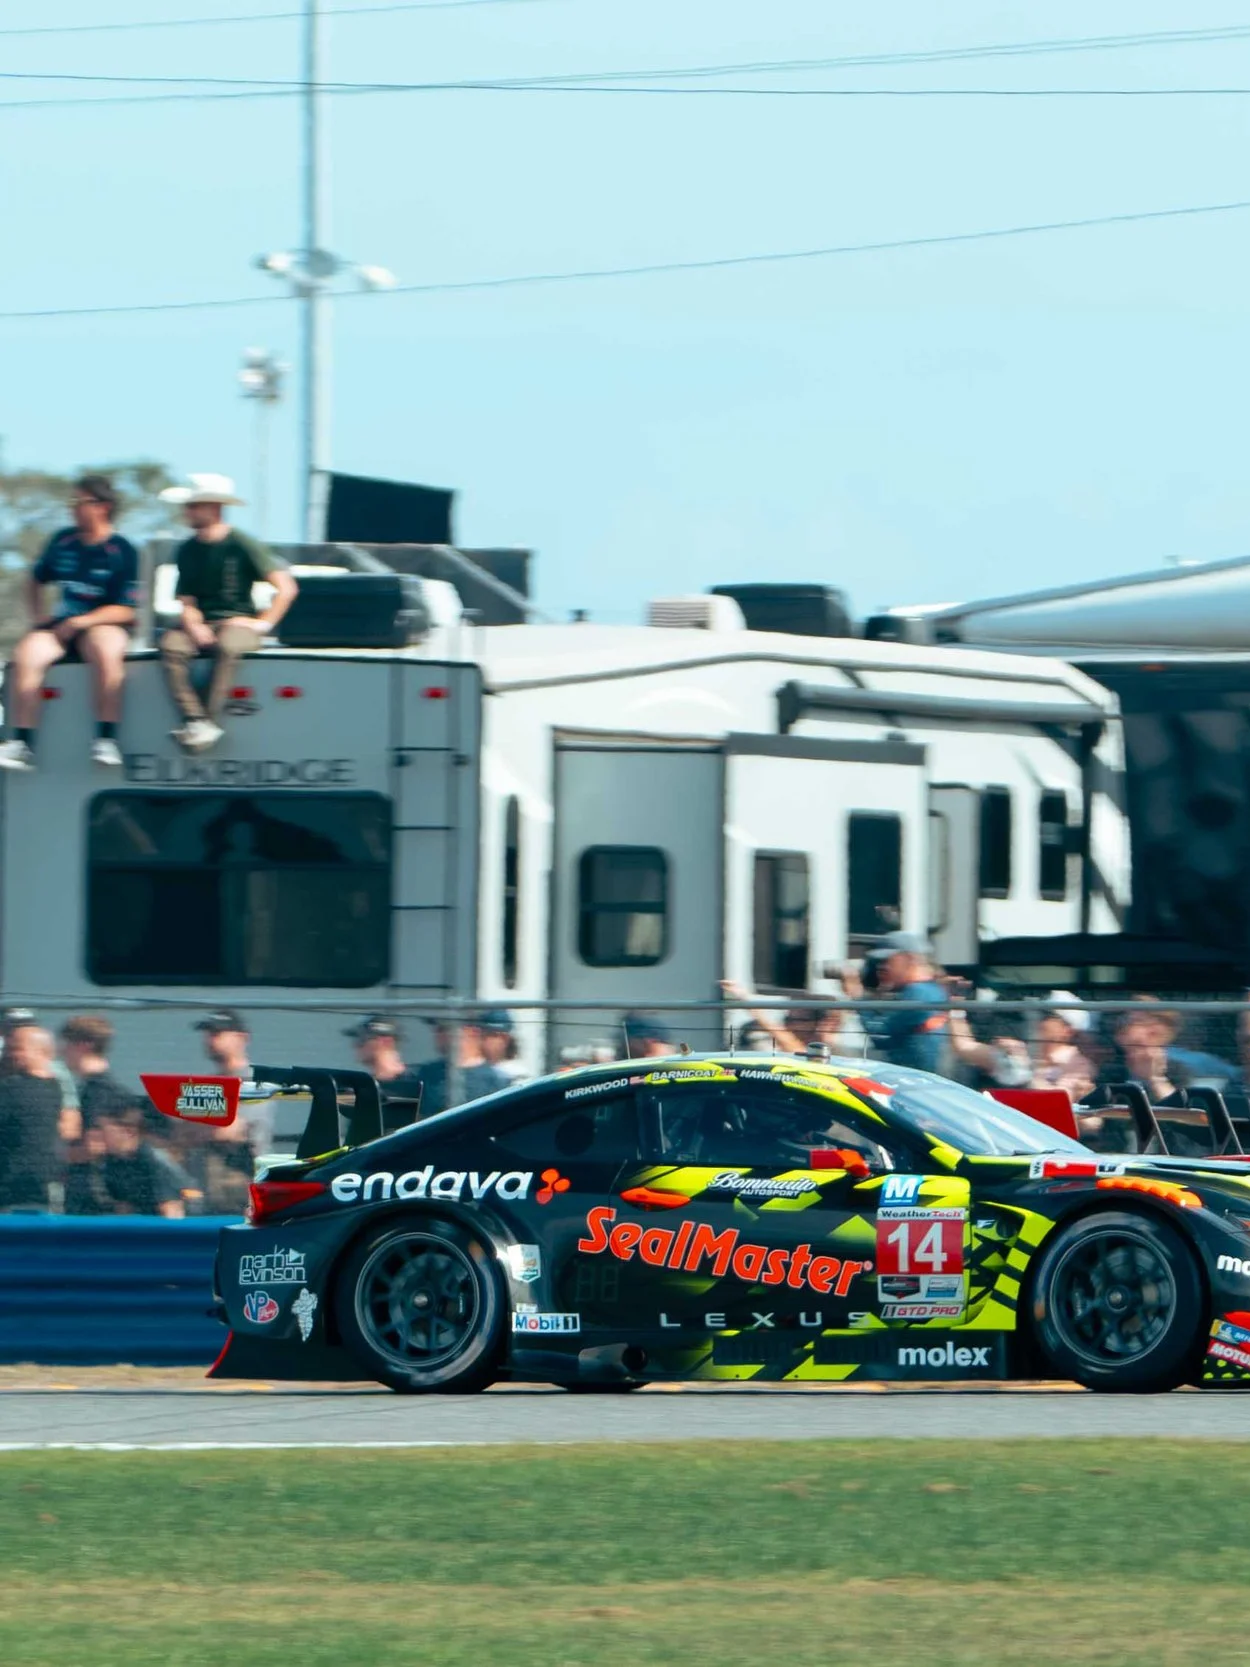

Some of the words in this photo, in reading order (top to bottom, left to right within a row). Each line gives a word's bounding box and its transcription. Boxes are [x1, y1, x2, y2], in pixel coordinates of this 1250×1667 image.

[651, 1068, 717, 1081] BARNICOAT
[181, 1084, 224, 1098] VASSER
[564, 1078, 629, 1100] KIRKWOOD
[176, 1098, 227, 1111] SULLIVAN
[331, 1164, 533, 1201] endava
[707, 1171, 817, 1192] Bommarito
[884, 1177, 919, 1199] M
[738, 1188, 800, 1198] AUTOSPORT
[881, 1209, 962, 1218] WeatherTech
[241, 1244, 285, 1268] mark
[578, 1205, 865, 1297] SealMaster
[887, 1222, 948, 1273] 14
[659, 1311, 870, 1329] LEXUS
[897, 1306, 927, 1316] GTD
[929, 1306, 960, 1316] PRO
[515, 1313, 560, 1330] Mobil
[898, 1341, 989, 1367] molex
